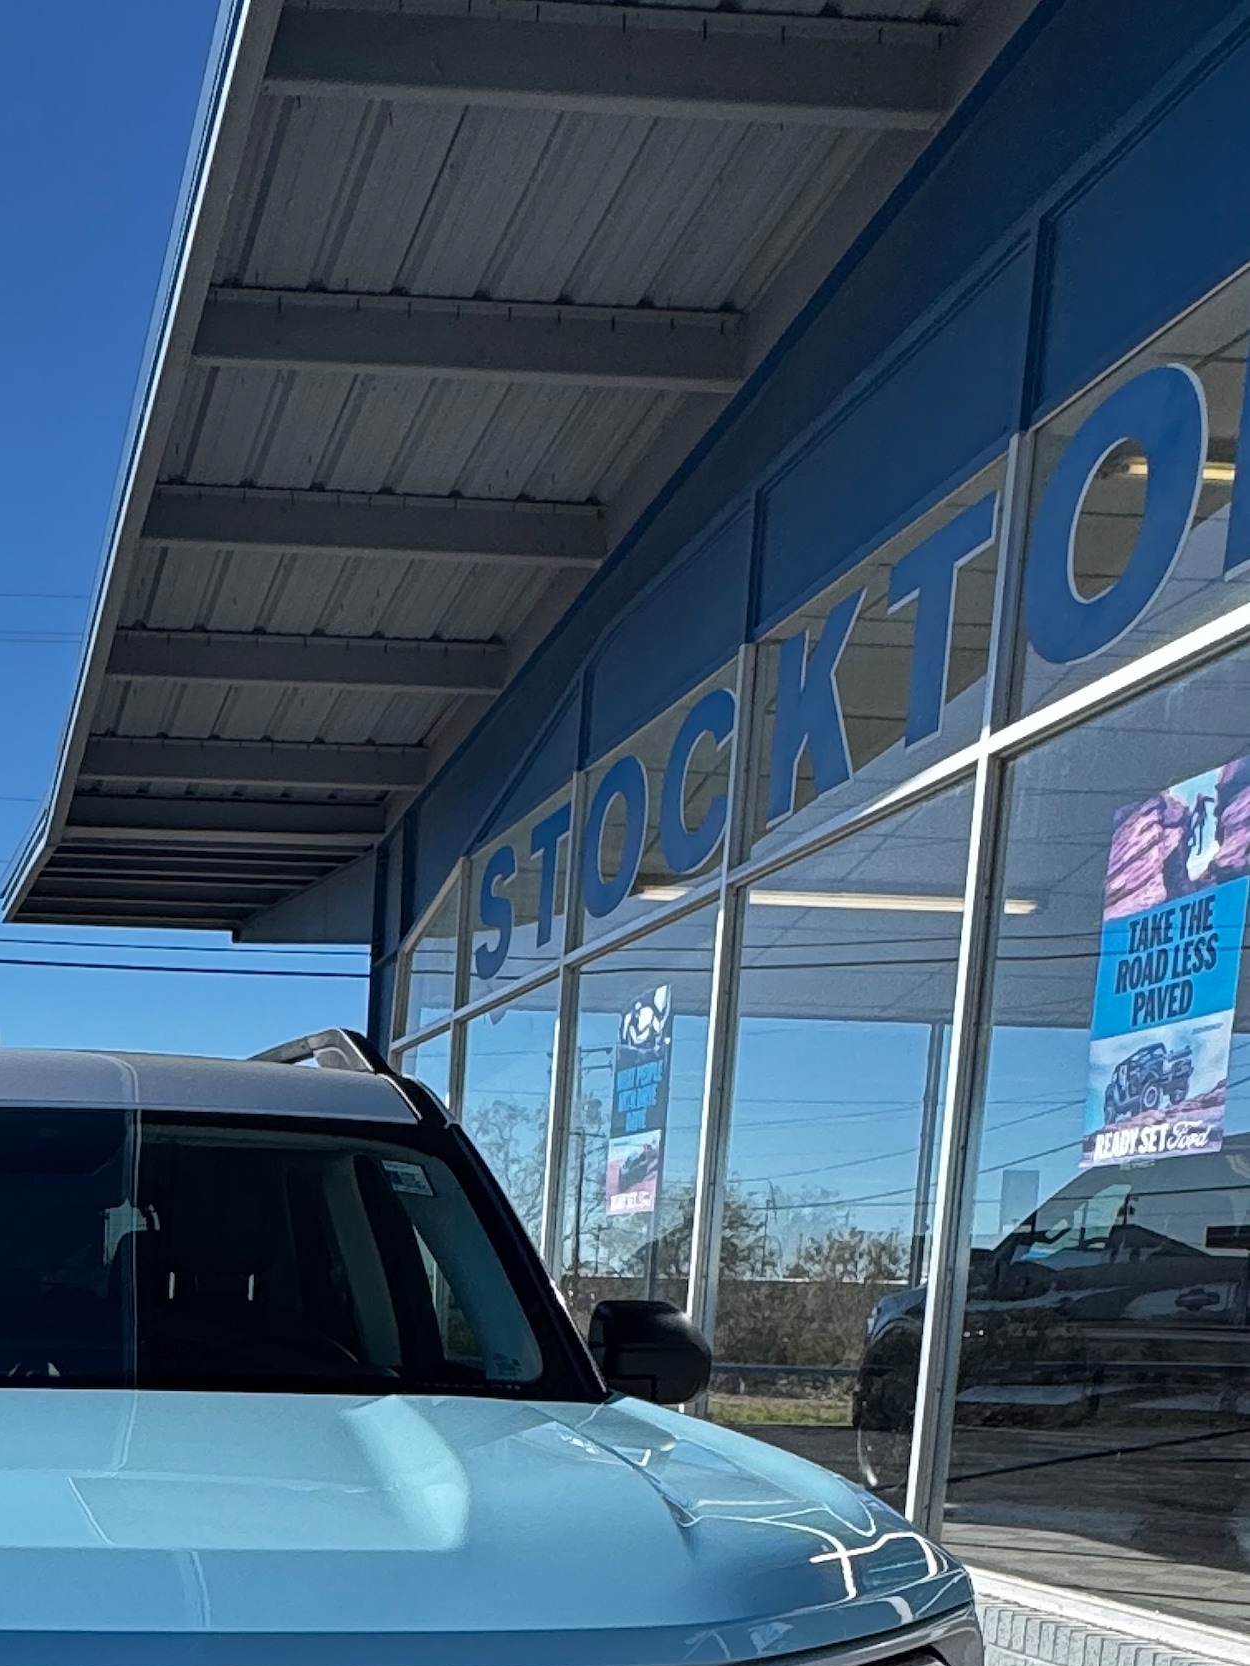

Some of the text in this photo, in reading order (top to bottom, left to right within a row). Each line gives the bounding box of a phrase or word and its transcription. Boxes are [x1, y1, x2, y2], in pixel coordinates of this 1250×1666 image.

[475, 335, 1250, 979] STOCKTO
[1128, 894, 1216, 954] TAKE THE
[1115, 933, 1218, 994] ROAD LESS
[1131, 979, 1193, 1027] PAVED
[1093, 1120, 1214, 1162] READY SET Ford
